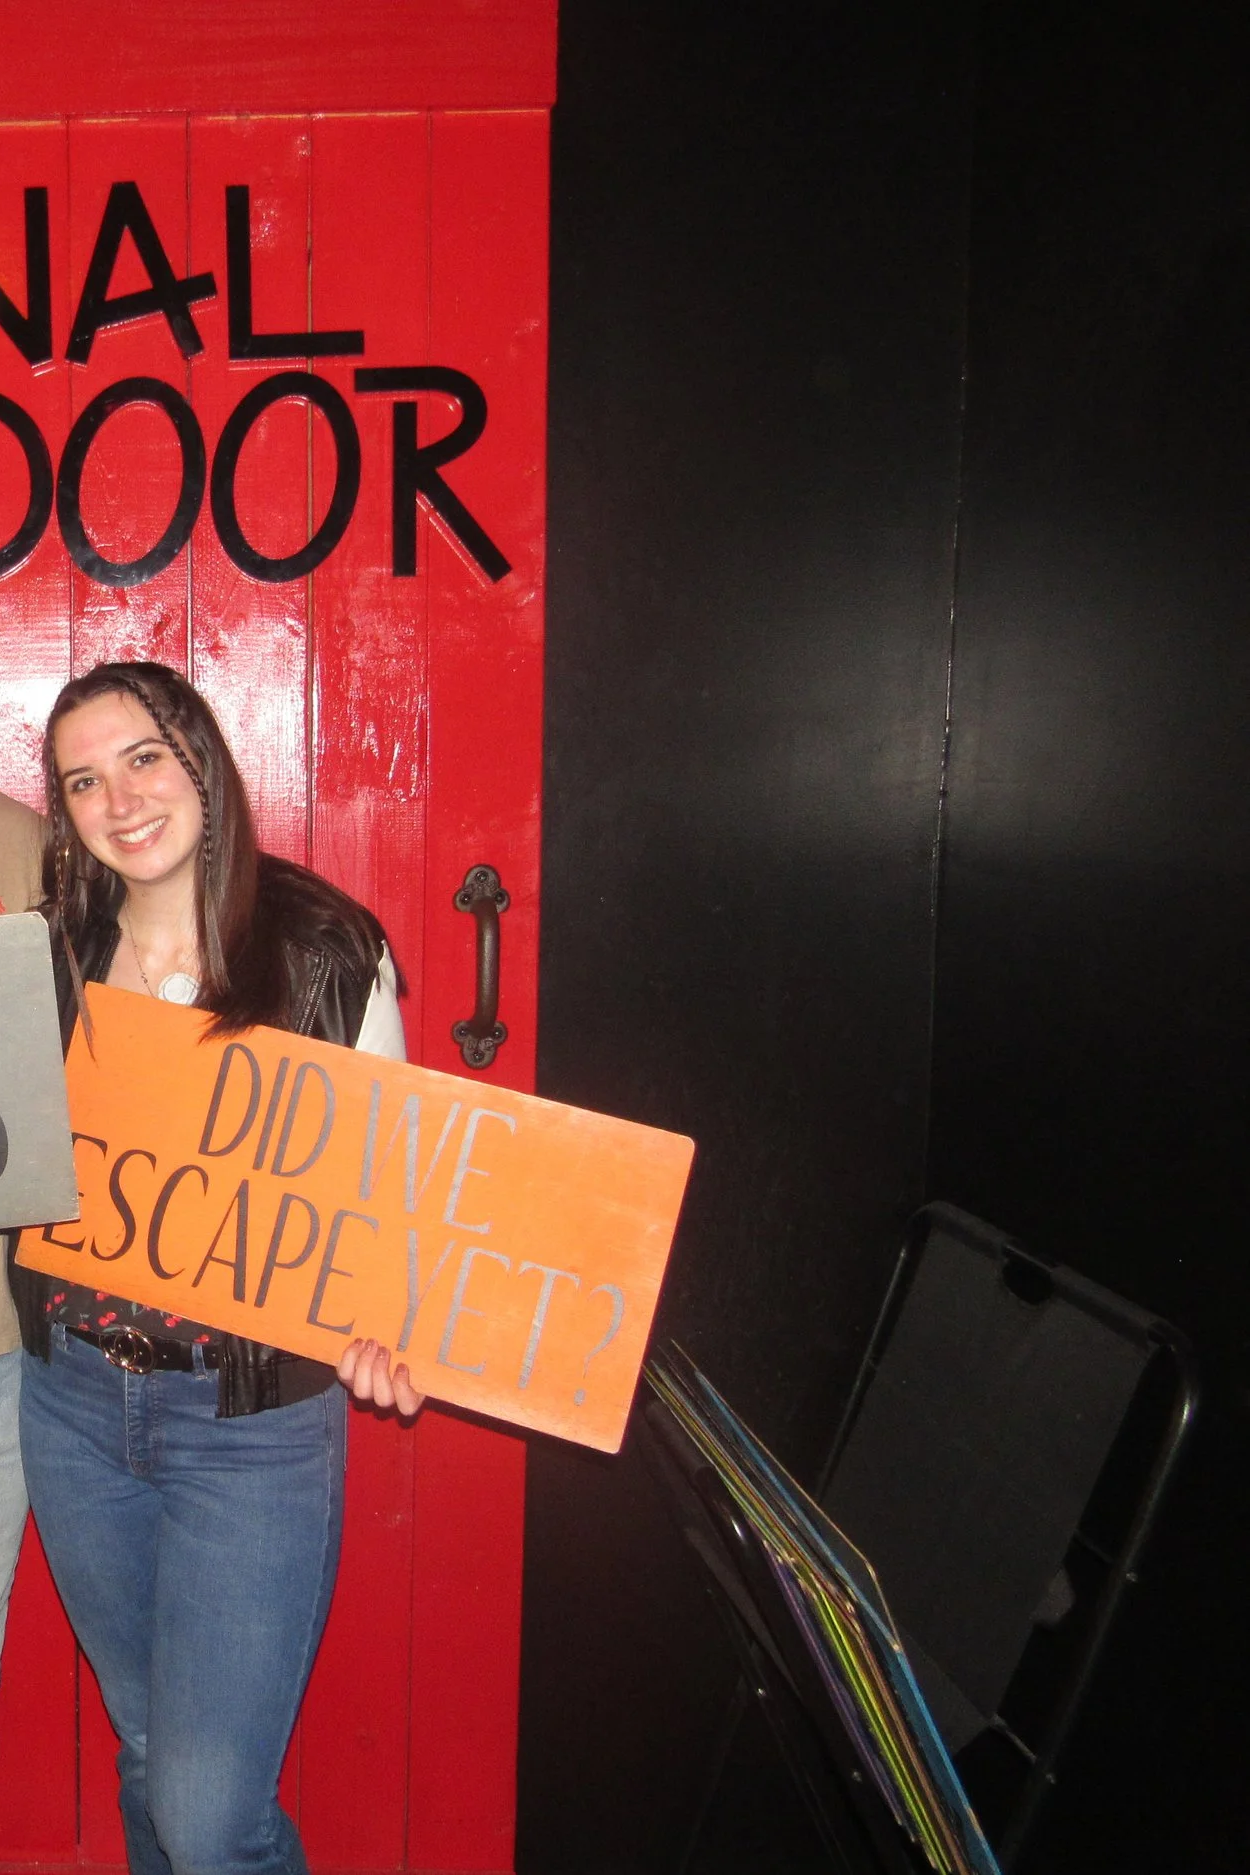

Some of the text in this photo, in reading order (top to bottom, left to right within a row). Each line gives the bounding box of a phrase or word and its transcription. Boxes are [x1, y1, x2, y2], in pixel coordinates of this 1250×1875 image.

[198, 1043, 518, 1235] DID WE
[396, 1228, 626, 1407] YET?
